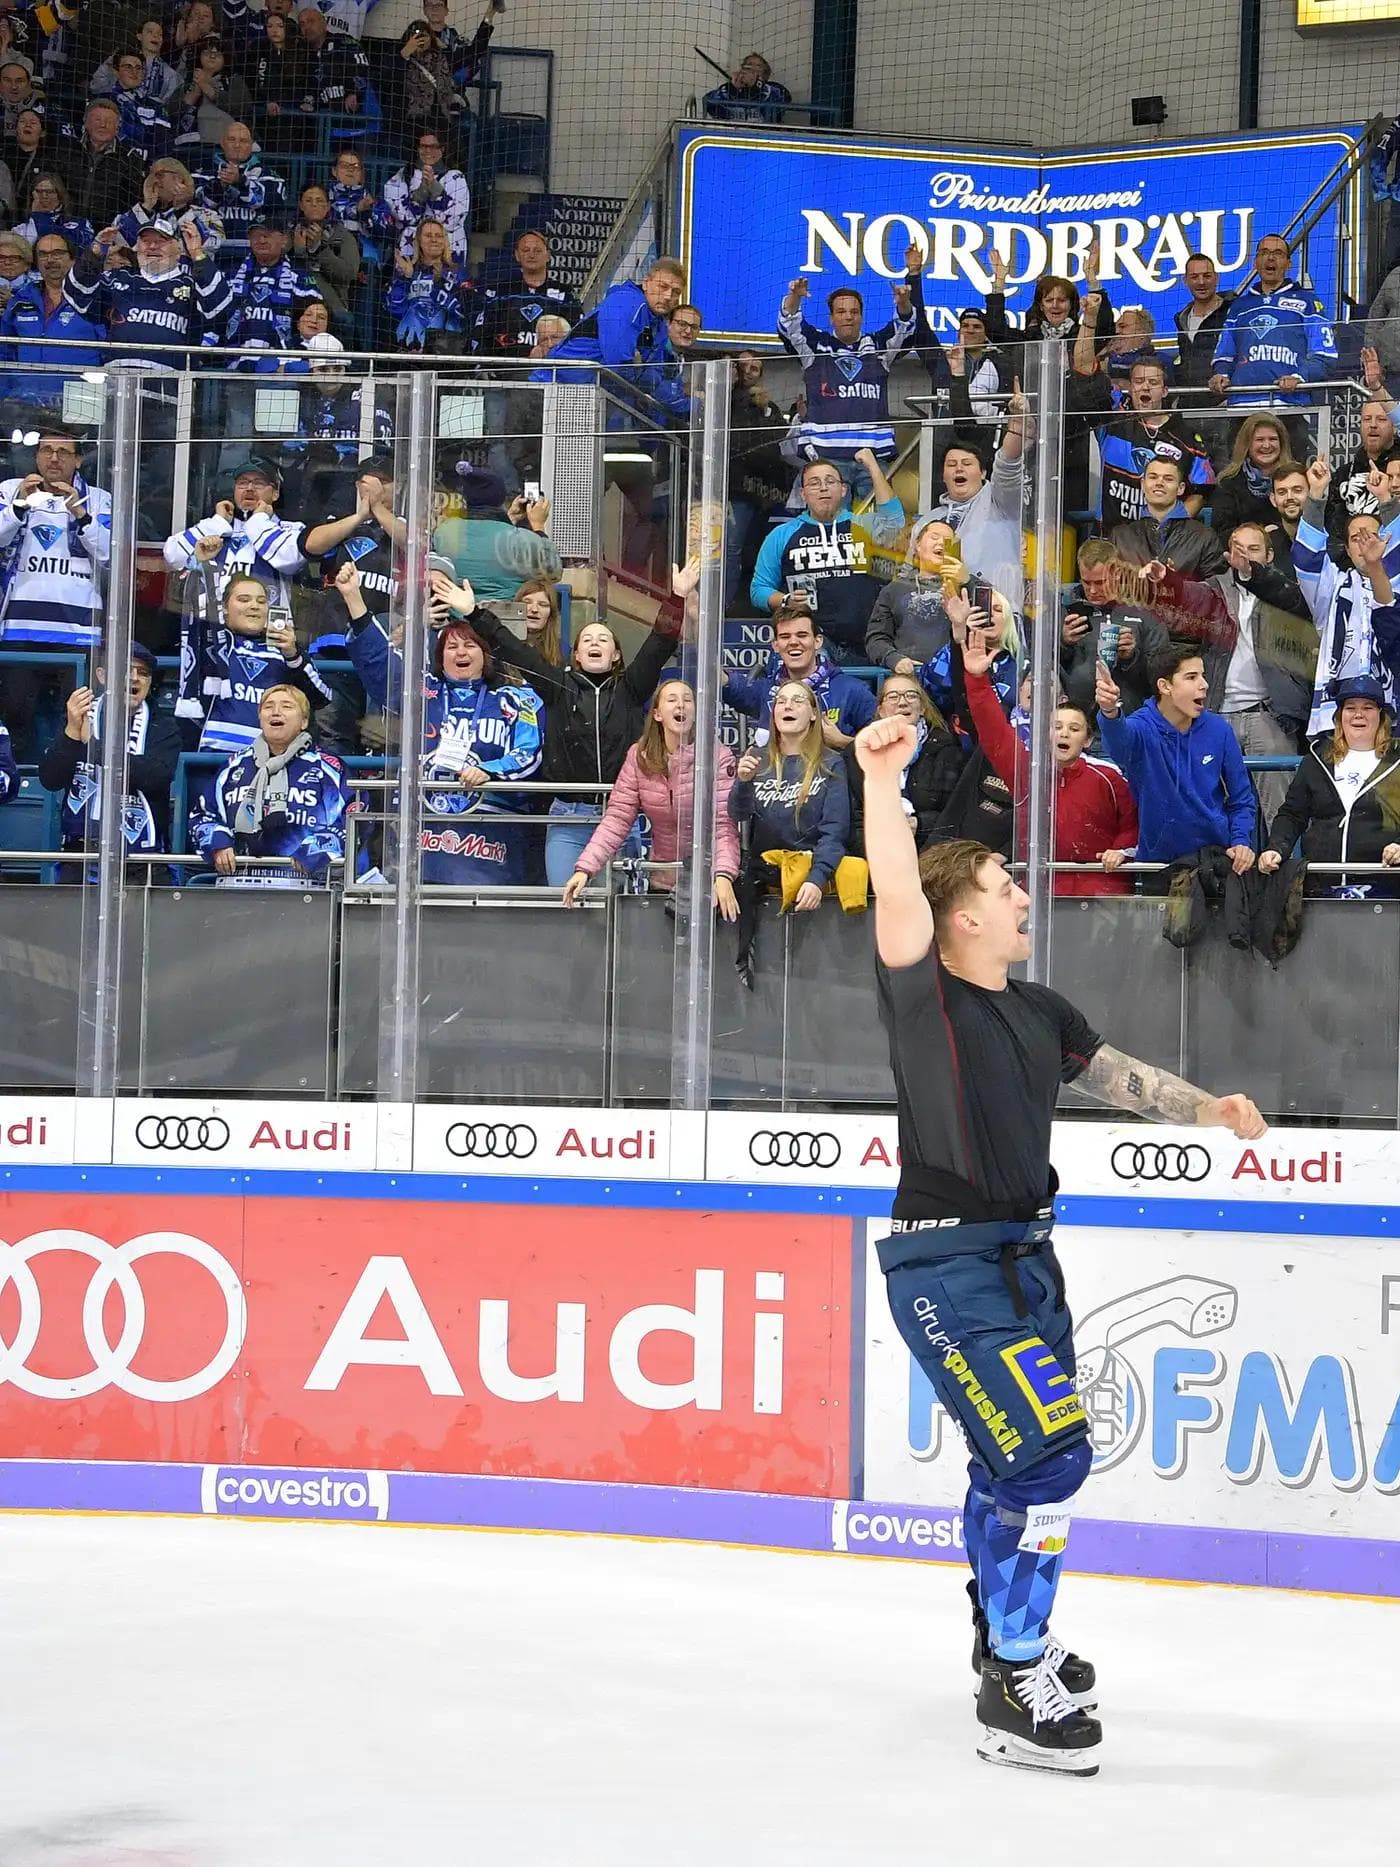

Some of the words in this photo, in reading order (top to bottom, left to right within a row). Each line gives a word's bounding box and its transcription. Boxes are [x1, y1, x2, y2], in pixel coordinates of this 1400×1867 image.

[929, 171, 1145, 215] Privatbrauerei
[545, 237, 606, 253] ORDB
[800, 206, 1255, 296] NORDBRÄU
[126, 307, 189, 334] SATURN
[789, 542, 867, 571] TEAM
[0, 1115, 48, 1146] di
[248, 1119, 352, 1152] Audi
[555, 1127, 656, 1160] Audi
[1231, 1148, 1344, 1184] Audi
[303, 1254, 785, 1416] Audi
[216, 1472, 371, 1509] covestro
